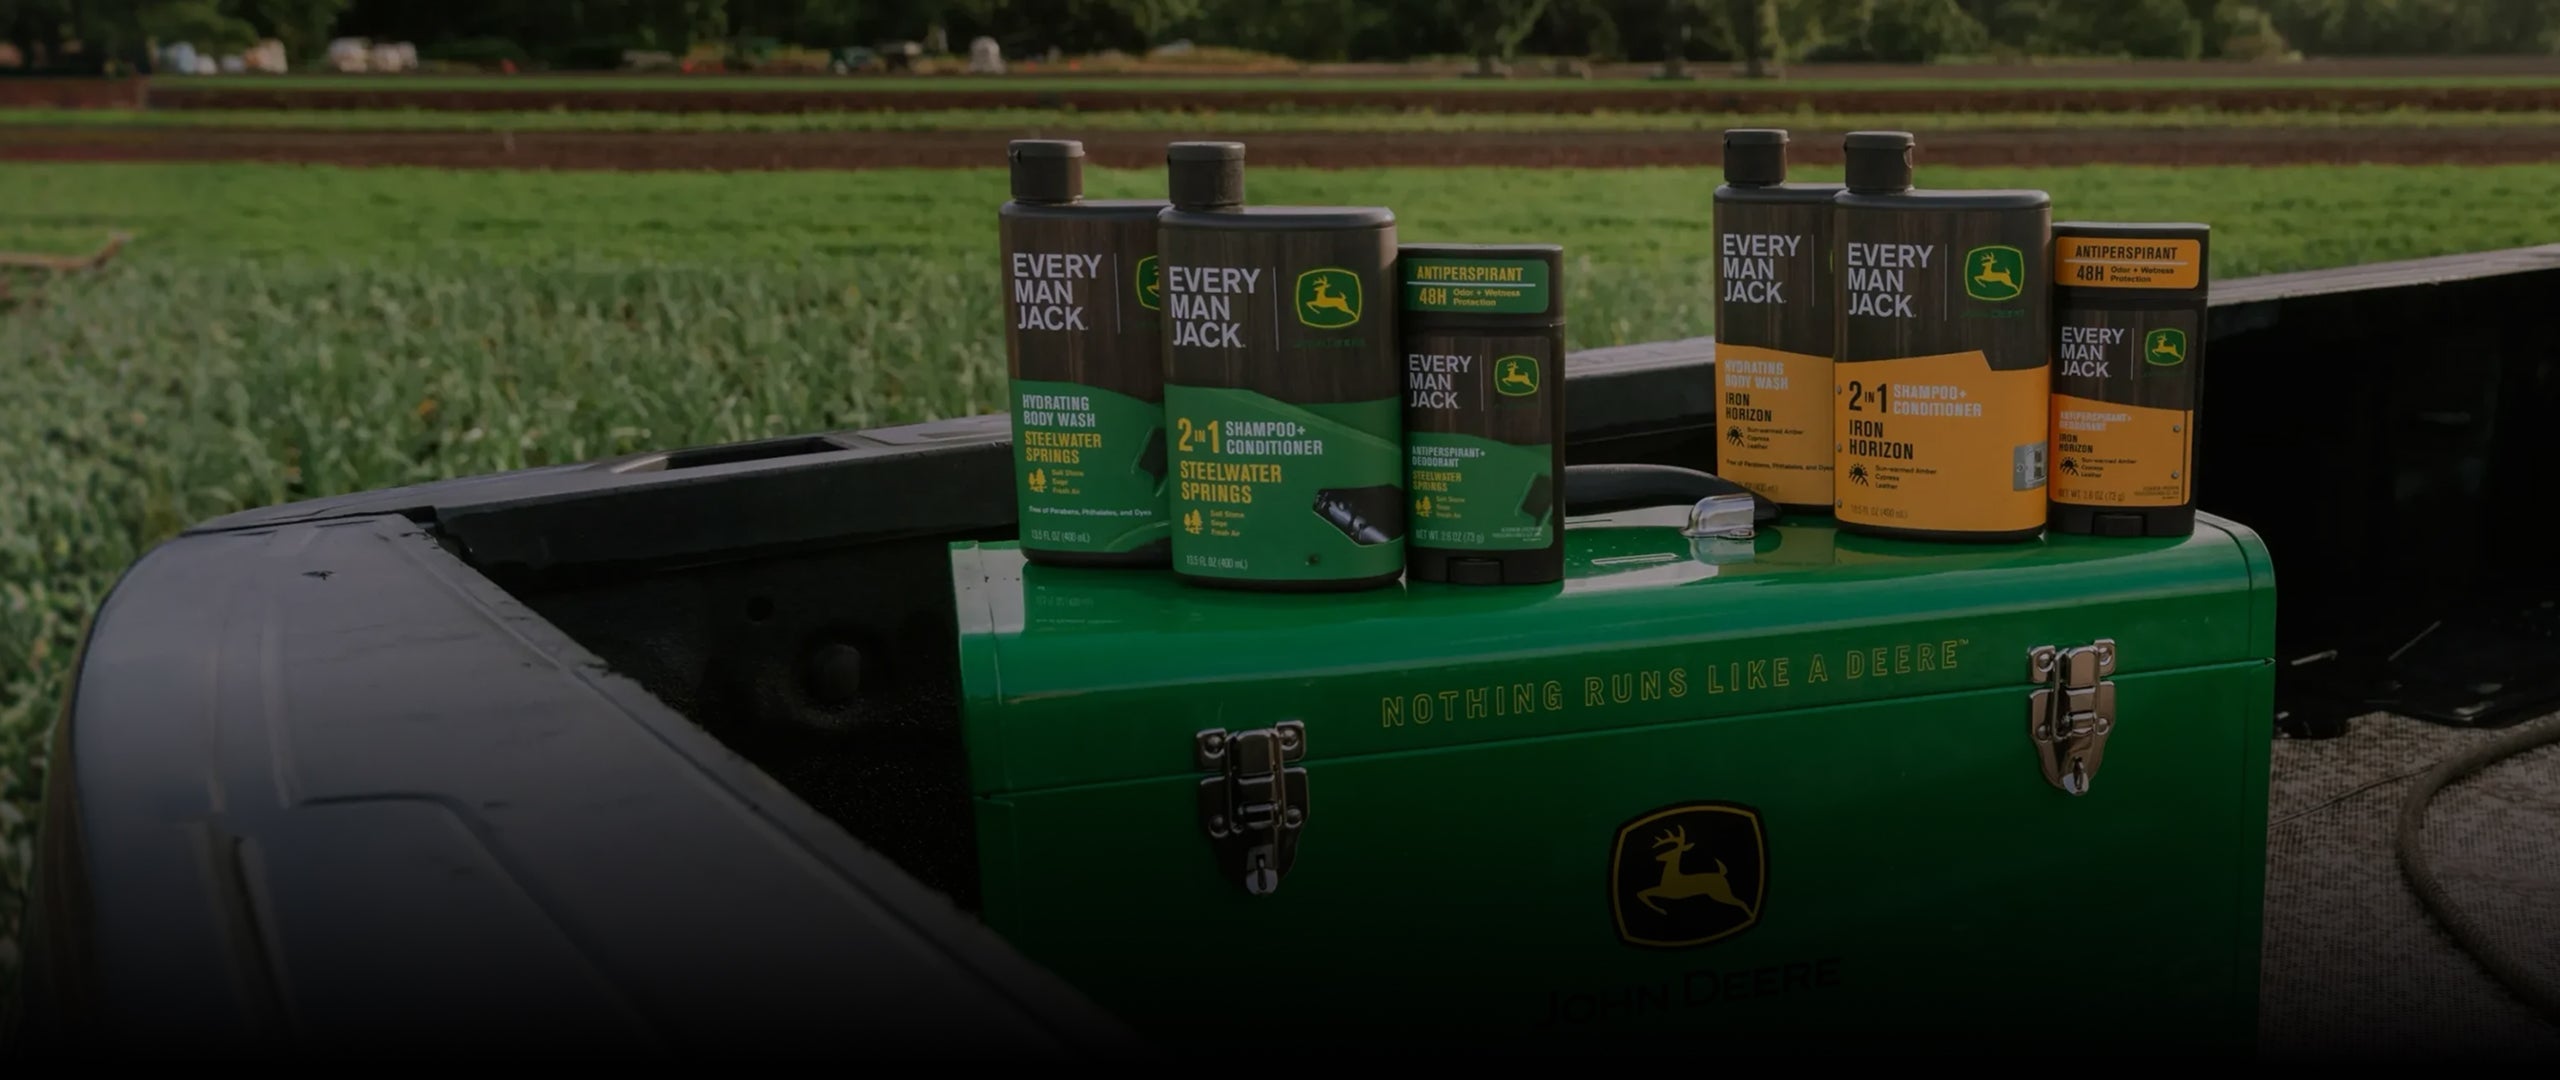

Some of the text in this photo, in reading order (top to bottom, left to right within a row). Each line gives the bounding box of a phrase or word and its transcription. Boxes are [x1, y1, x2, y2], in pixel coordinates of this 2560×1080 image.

[1723, 233, 1801, 257] EVERY
[2075, 246, 2178, 259] ANTIPERSPIRANT
[1848, 242, 1934, 268] EVERY
[1012, 252, 1102, 279] EVERY
[1416, 265, 1523, 282] ANTIPERSPIRANT
[1723, 257, 1774, 280] MAN
[2077, 265, 2104, 281] 48H
[1169, 265, 1261, 294] EVERY
[1848, 268, 1903, 292] MAN
[1014, 279, 1073, 304] MAN
[1419, 287, 1447, 305] 48H
[1453, 288, 1473, 296] Odor
[1484, 289, 1521, 297] Wetness
[1171, 294, 1230, 321] MAN
[1453, 298, 1496, 306] Protection
[2061, 326, 2124, 344] EVERY
[2061, 343, 2103, 360] MAN
[1408, 354, 1472, 373] EVERY
[1725, 359, 1784, 375] HYDRATING
[1409, 372, 1451, 390] MAN
[1725, 374, 1789, 390] BODY WASH
[1022, 394, 1090, 411] HYDRATING
[1726, 392, 1750, 406] IRON
[1726, 407, 1772, 422] HORIZON
[1893, 402, 1982, 417] CONDITIONER
[1024, 411, 1096, 428] BODY WASH
[1850, 420, 1883, 437] IRON
[2059, 432, 2078, 442] IRON
[1025, 431, 1102, 448] STEELWATER
[1226, 440, 1323, 455] CONDITIONER
[2059, 443, 2093, 453] HORIZON
[1026, 447, 1080, 464] SPRINGS
[1850, 439, 1913, 459] HORIZON
[1180, 460, 1282, 483] STEELWATER
[1181, 481, 1252, 504] SPRINGS
[1382, 680, 1563, 728] NOTHING
[1584, 667, 1688, 707] RUNS
[1708, 657, 1791, 694] LIKE
[1807, 653, 1829, 684] A
[1534, 956, 1844, 1031] JOHN DEERE
